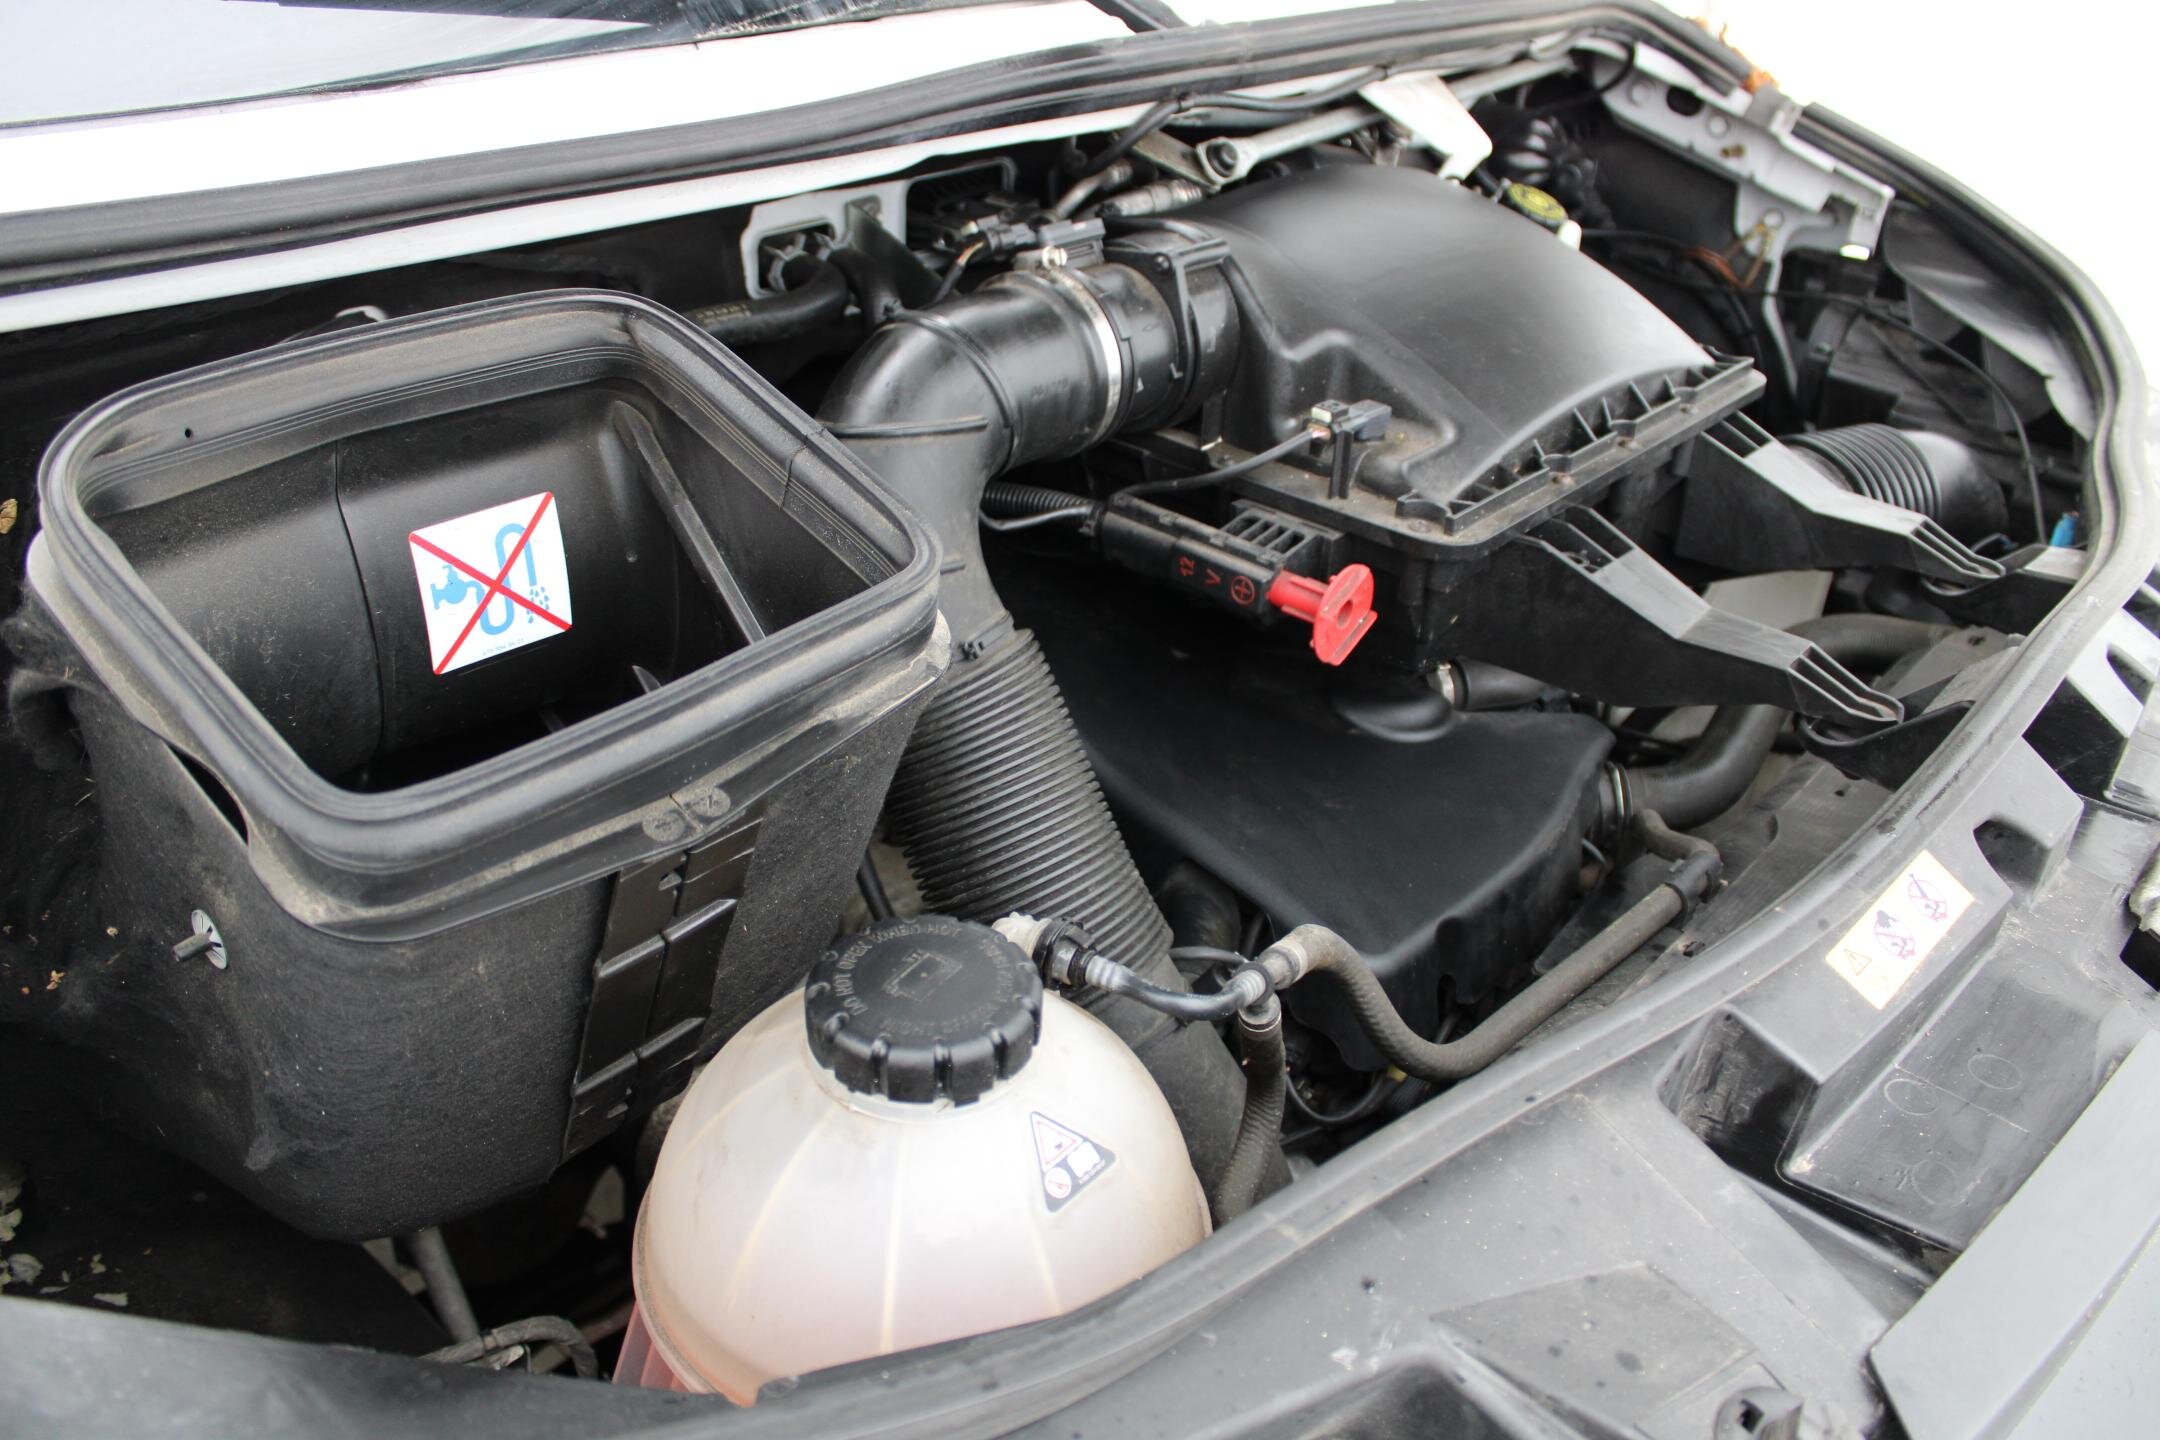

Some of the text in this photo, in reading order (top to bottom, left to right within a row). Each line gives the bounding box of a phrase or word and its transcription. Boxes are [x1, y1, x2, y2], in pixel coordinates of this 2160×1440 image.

[832, 923, 963, 1016] DO NOT OPEN WHEN HOT
